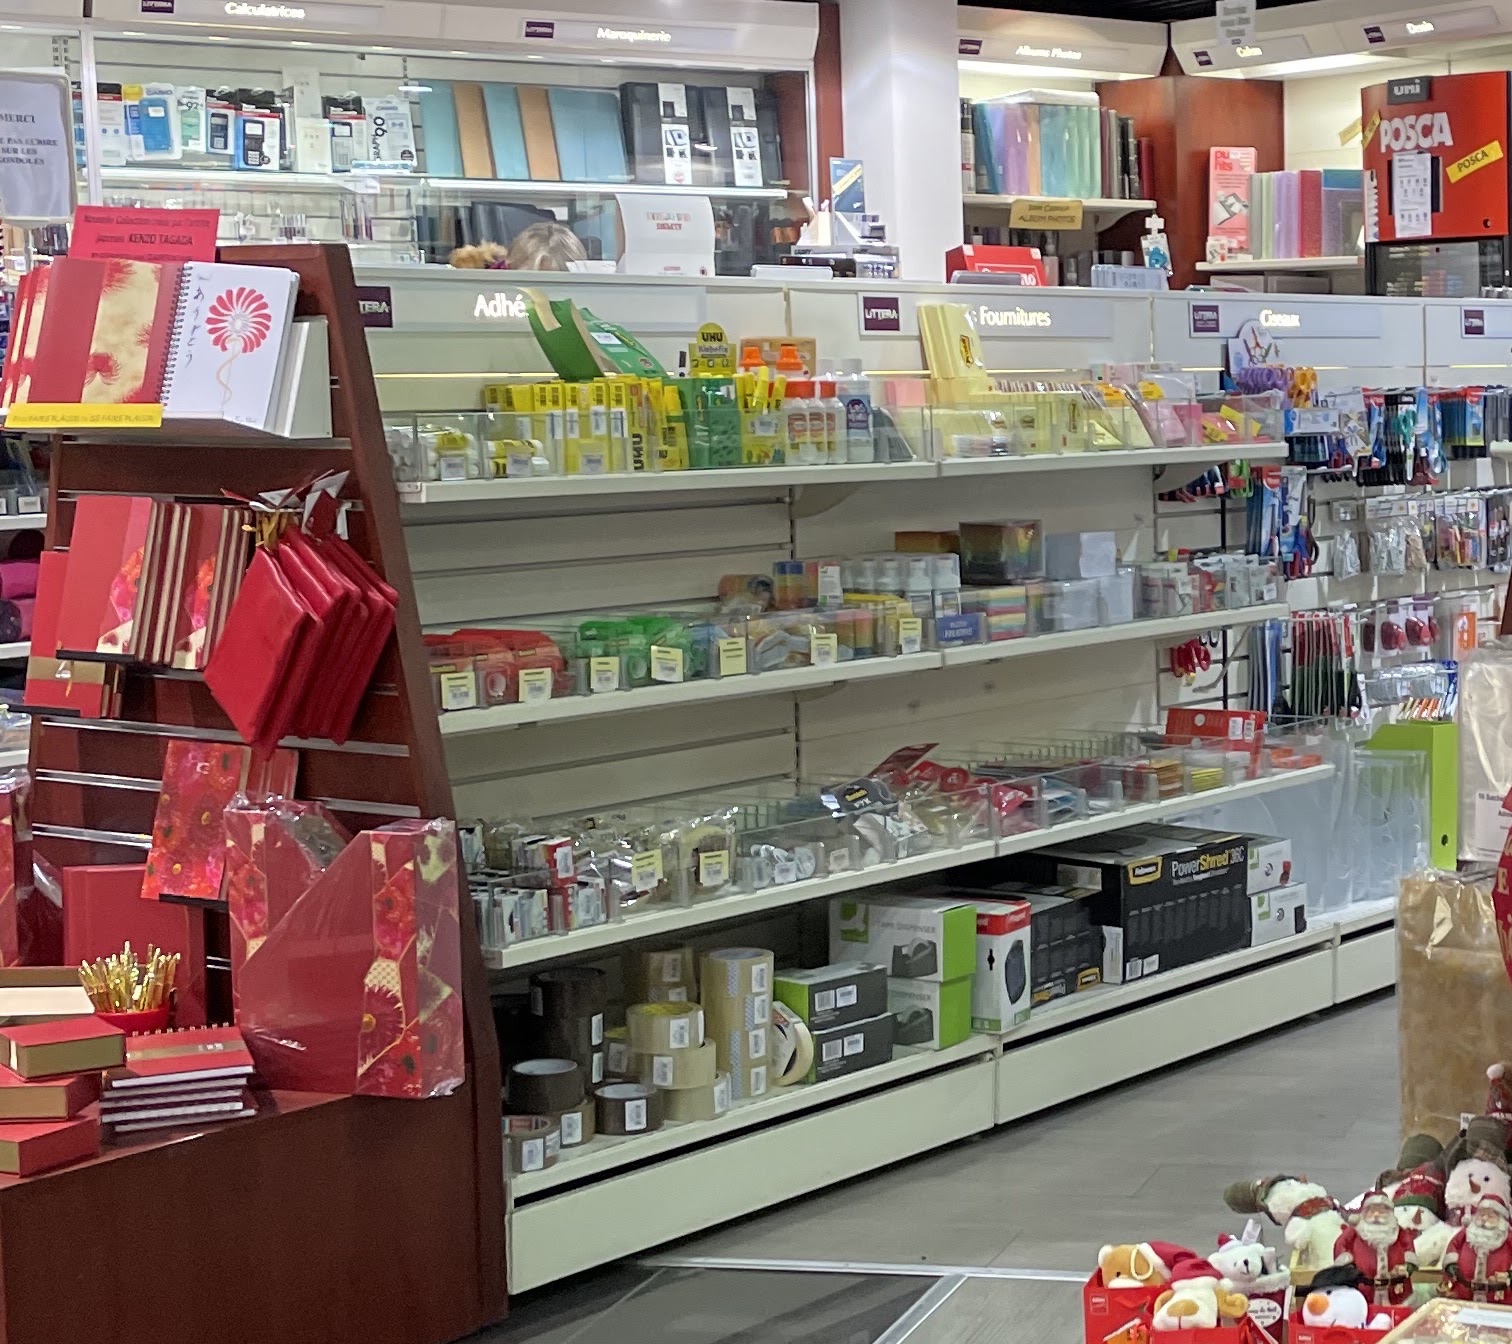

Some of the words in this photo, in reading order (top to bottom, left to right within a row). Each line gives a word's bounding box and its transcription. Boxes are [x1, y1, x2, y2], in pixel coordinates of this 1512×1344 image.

[1393, 78, 1421, 96] uni
[1379, 111, 1454, 154] POSCA
[1457, 149, 1490, 173] POSCA
[358, 299, 391, 315] TERA
[474, 292, 529, 318] Adhé
[979, 305, 1052, 327] Fournitures
[701, 331, 723, 343] UHU
[1171, 851, 1230, 878] PowerShred
